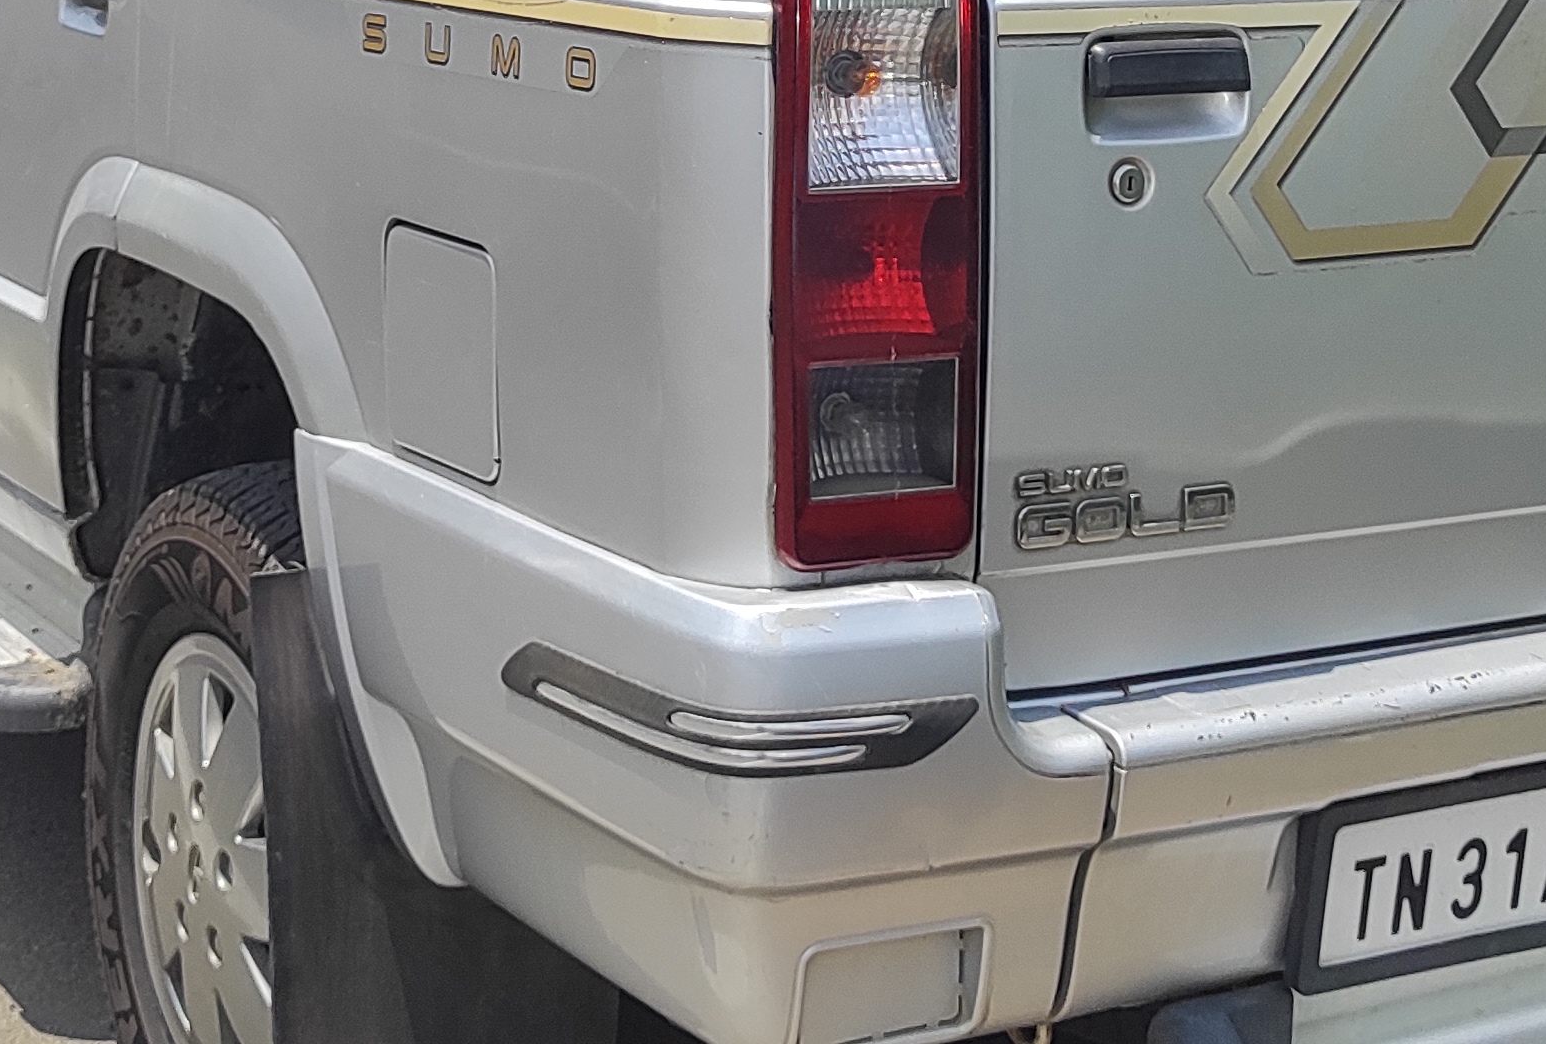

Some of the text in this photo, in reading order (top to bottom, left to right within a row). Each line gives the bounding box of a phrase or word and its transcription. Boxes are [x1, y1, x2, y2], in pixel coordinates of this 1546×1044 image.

[362, 12, 597, 93] SUMO
[1015, 462, 1128, 498] SUMO
[1015, 480, 1236, 550] GOLD
